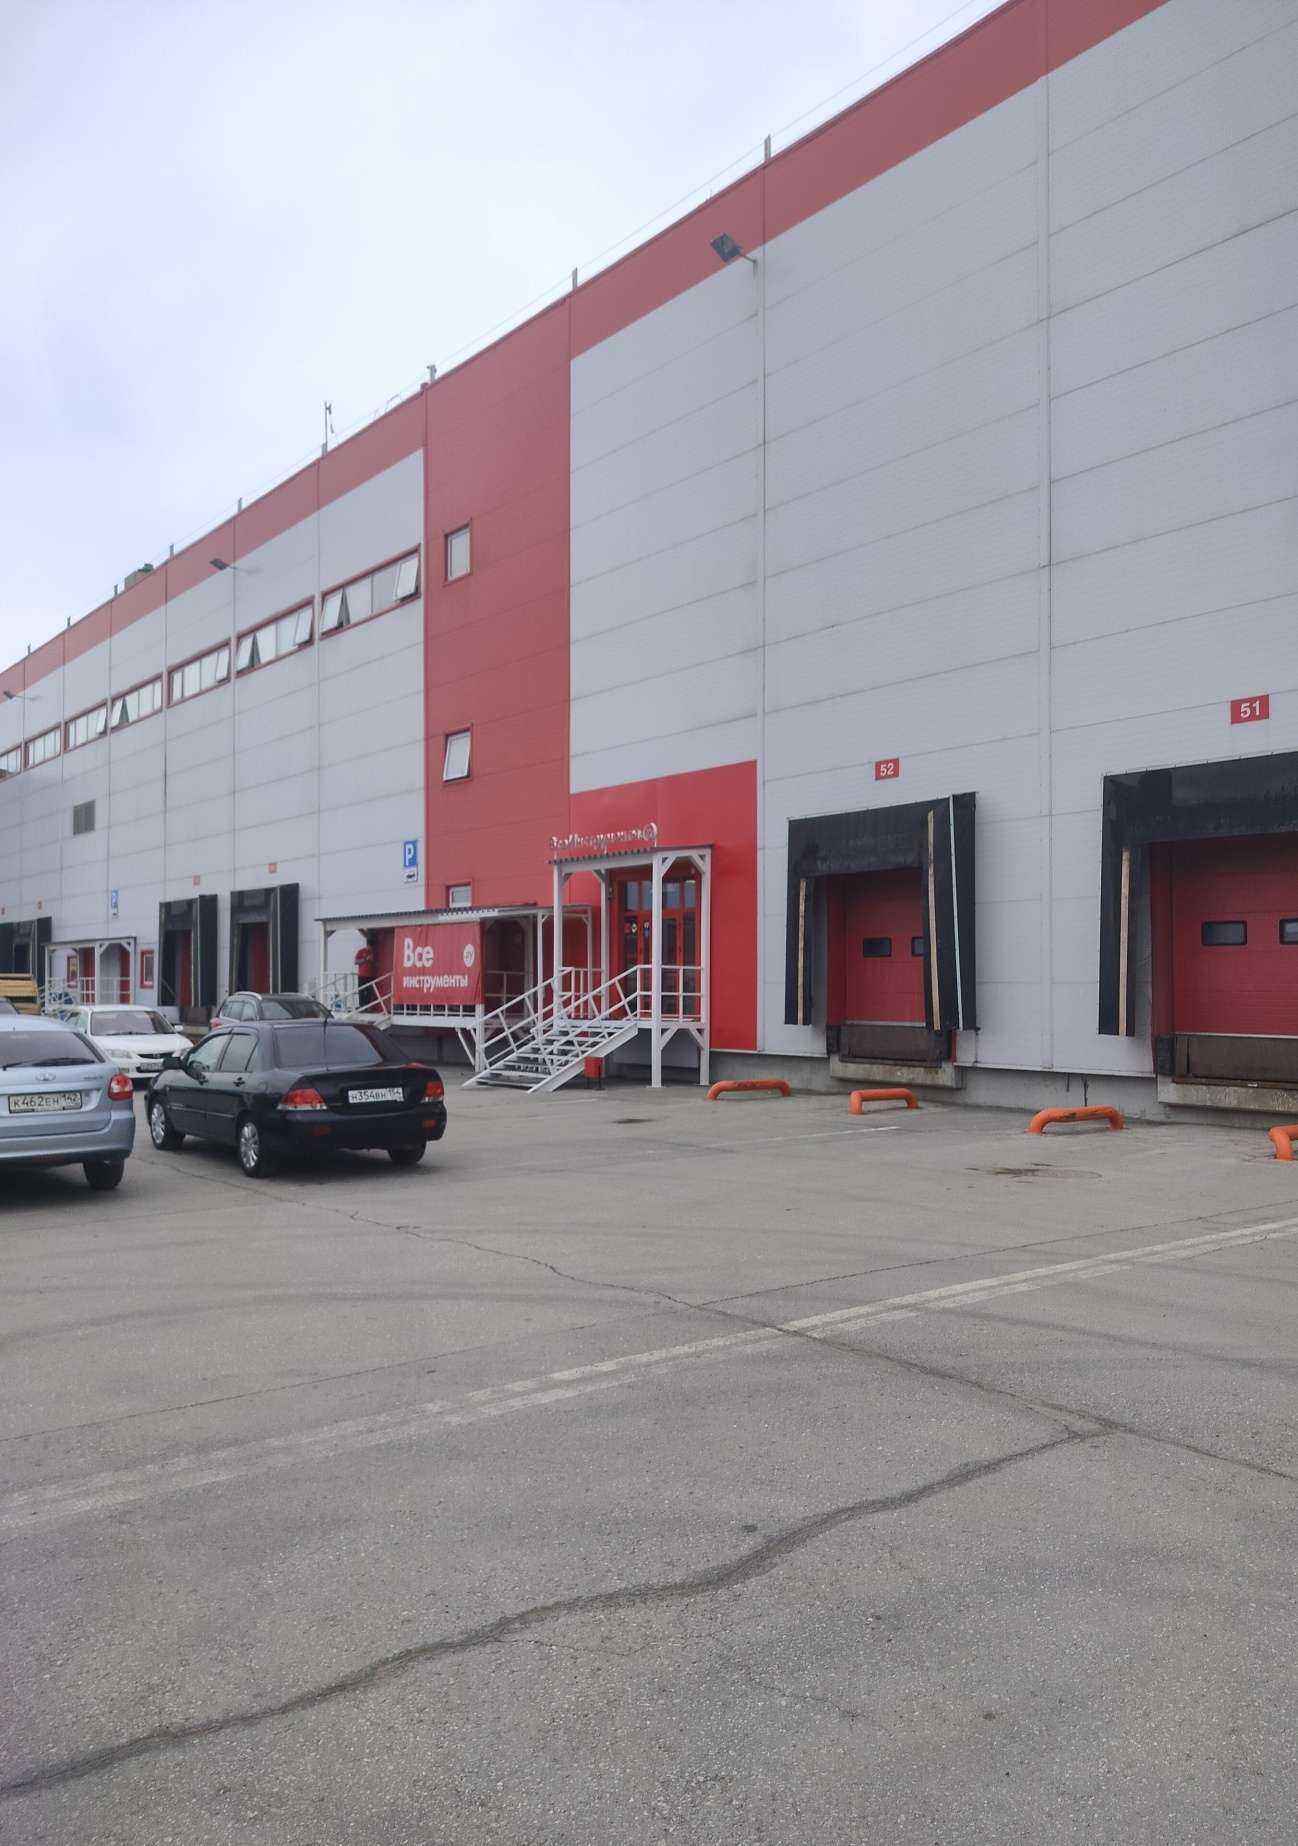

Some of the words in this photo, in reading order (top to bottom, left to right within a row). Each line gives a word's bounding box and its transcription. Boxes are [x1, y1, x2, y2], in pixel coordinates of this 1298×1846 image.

[1240, 700, 1260, 718] 51
[880, 762, 895, 777] 52
[405, 843, 415, 865] P
[403, 937, 434, 968] Все
[403, 974, 469, 993] инструменты
